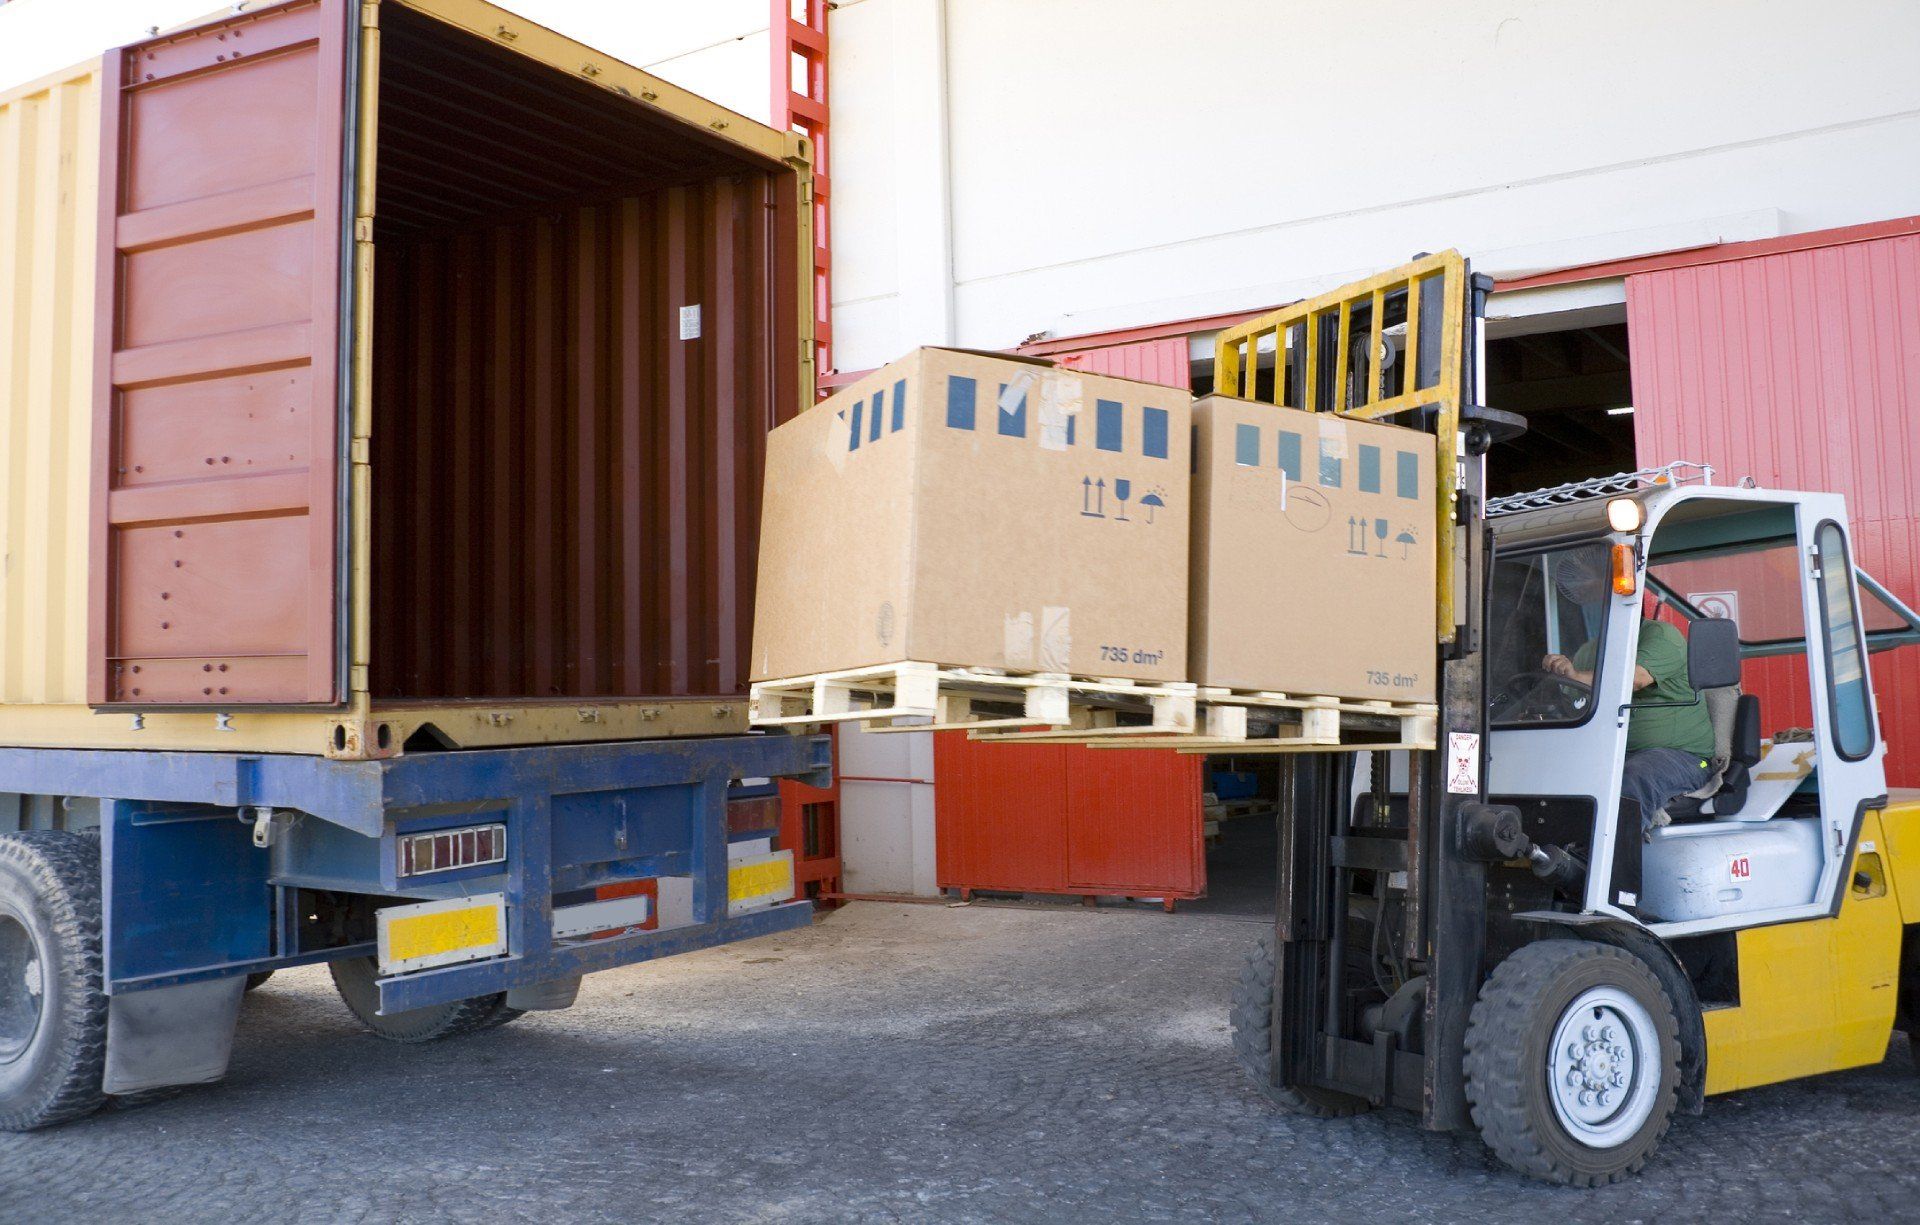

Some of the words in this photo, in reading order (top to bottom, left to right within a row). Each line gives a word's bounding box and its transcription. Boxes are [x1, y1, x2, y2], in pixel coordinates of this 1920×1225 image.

[1101, 646, 1128, 663] 735
[1366, 671, 1390, 686] 735
[1731, 858, 1750, 877] 40
